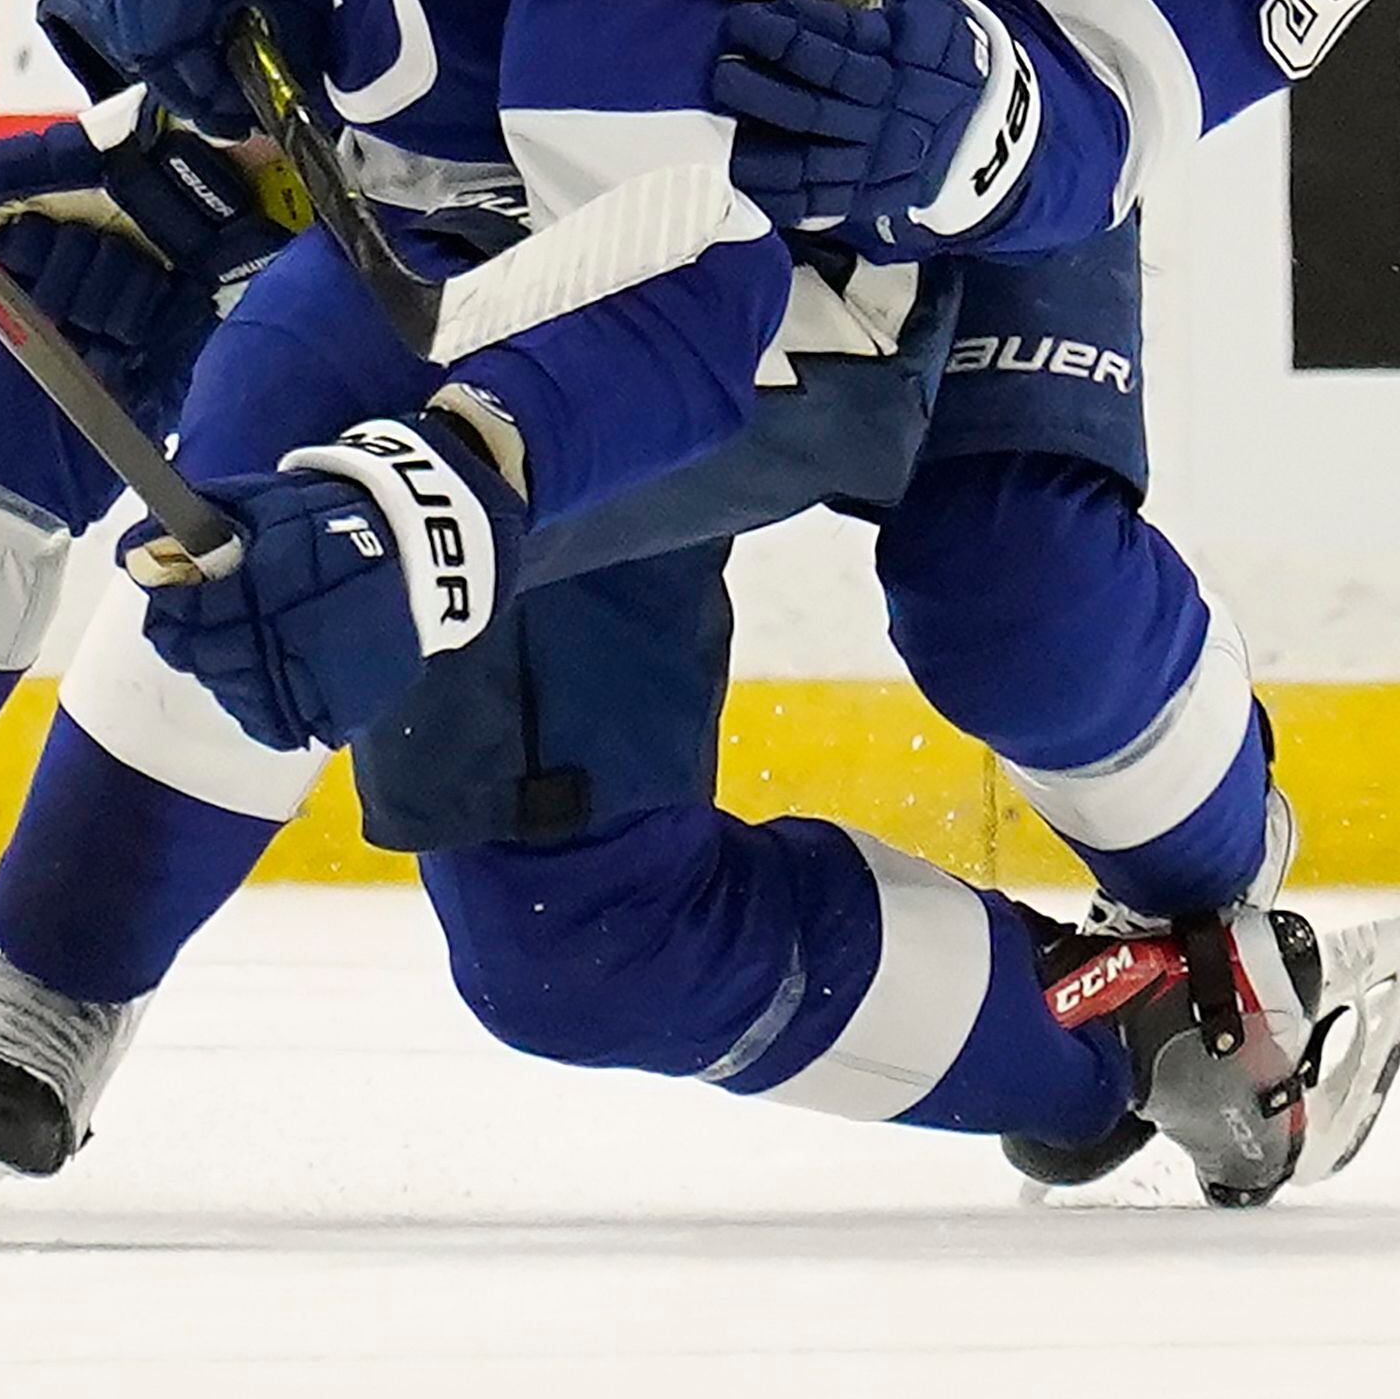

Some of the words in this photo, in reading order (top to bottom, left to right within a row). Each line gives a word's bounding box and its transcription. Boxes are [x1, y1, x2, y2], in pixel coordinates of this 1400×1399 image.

[169, 157, 235, 218] BAUER
[945, 336, 1138, 394] AUER
[1054, 945, 1136, 1014] CCM
